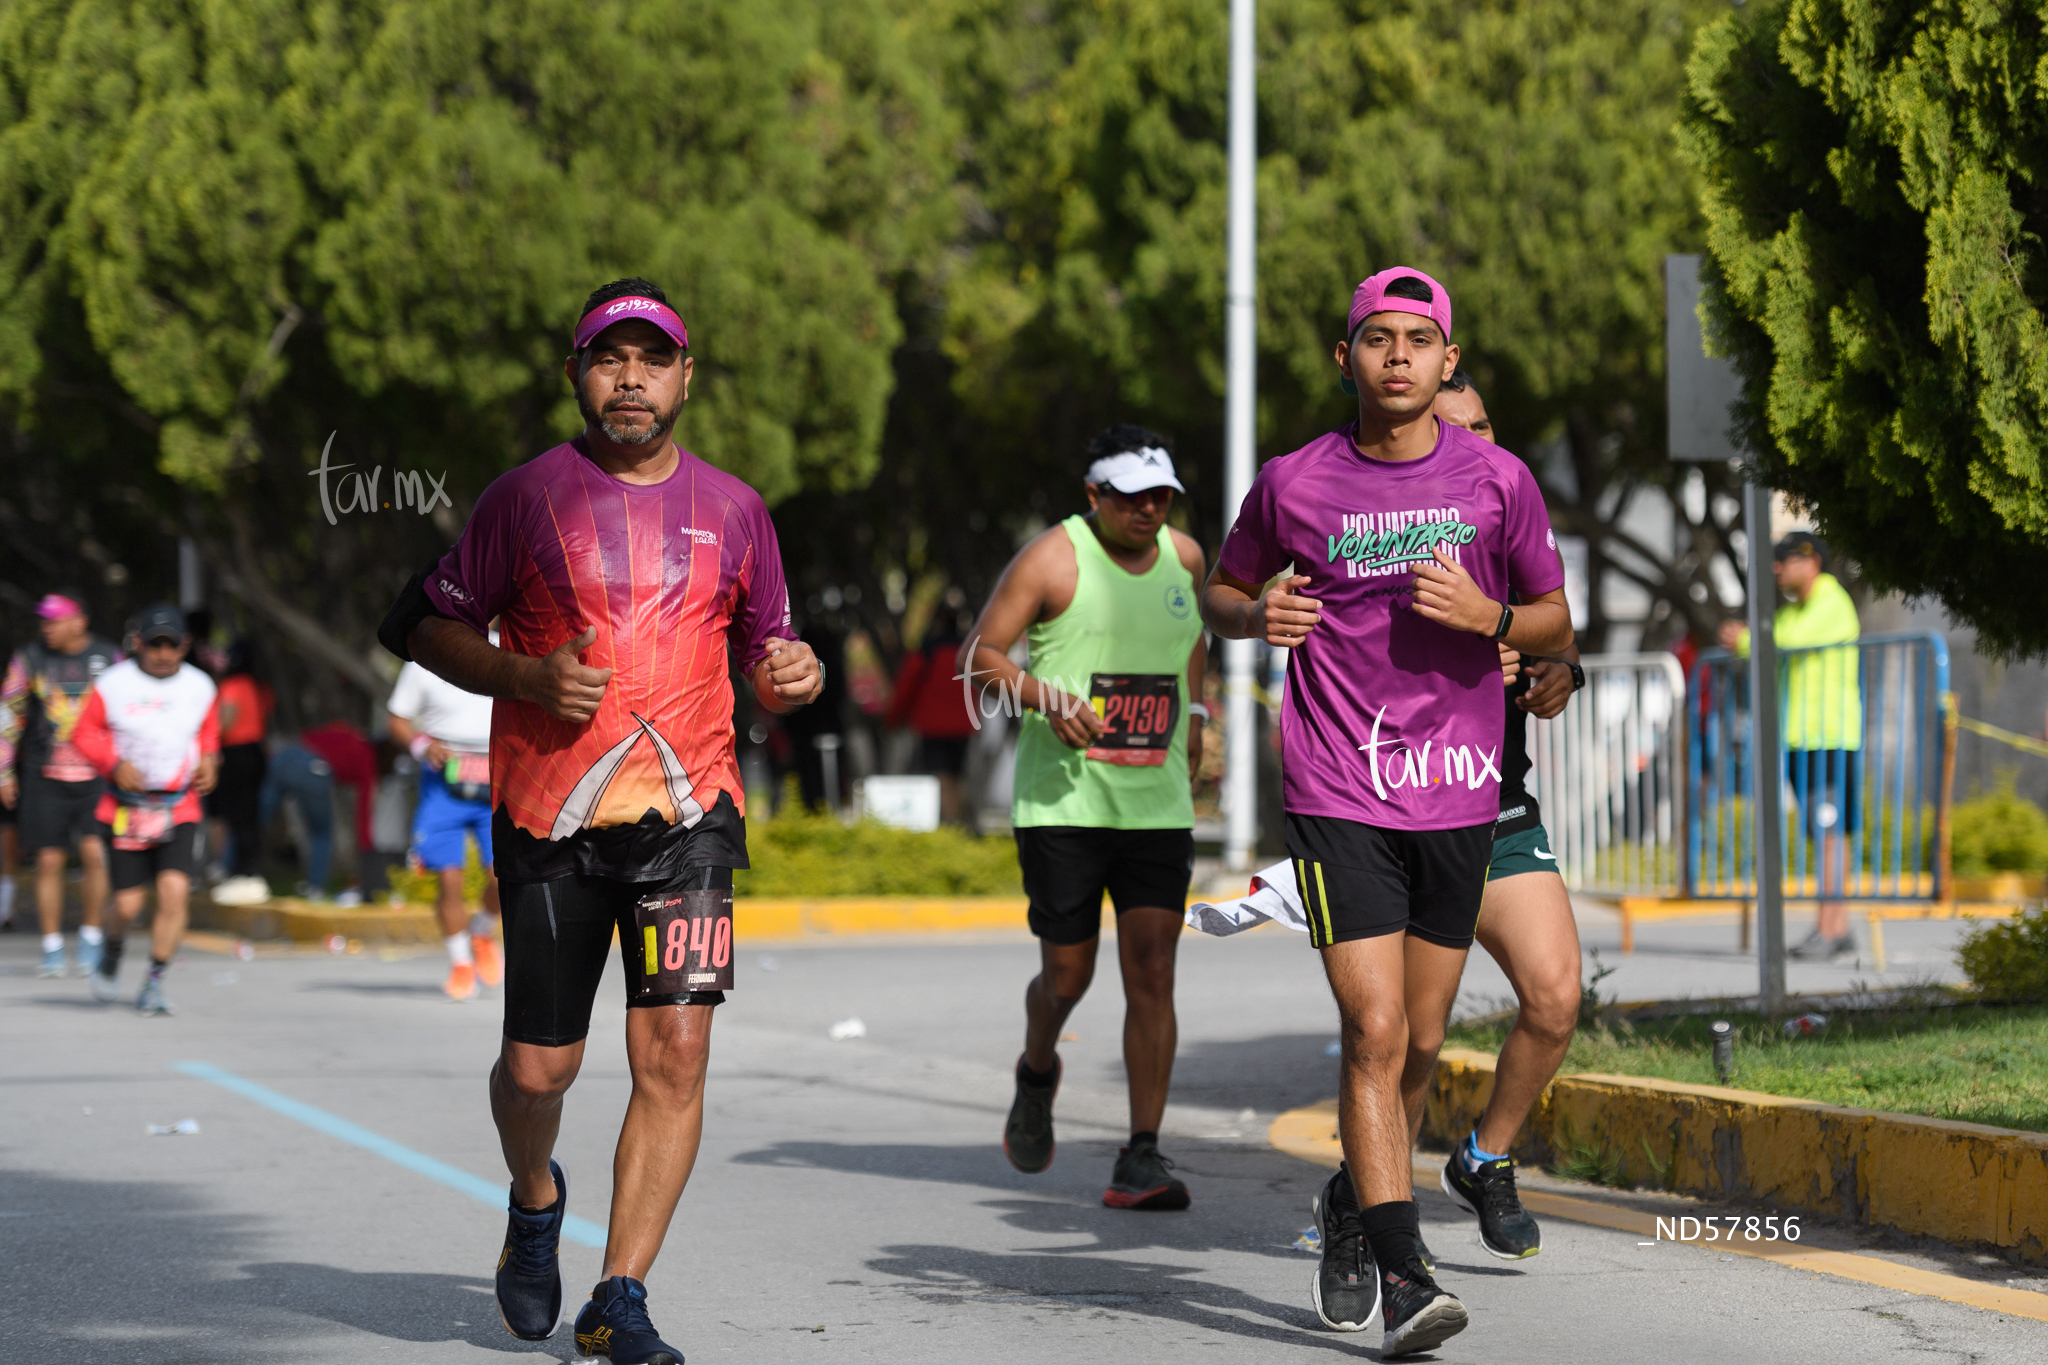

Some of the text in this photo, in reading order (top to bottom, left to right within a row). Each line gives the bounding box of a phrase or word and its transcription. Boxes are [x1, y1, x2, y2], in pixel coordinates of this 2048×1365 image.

[1327, 520, 1478, 564] VOLUNTARIO
[1102, 695, 1170, 734] 2430
[664, 916, 731, 970] 840
[688, 973, 716, 983] FERNANDO
